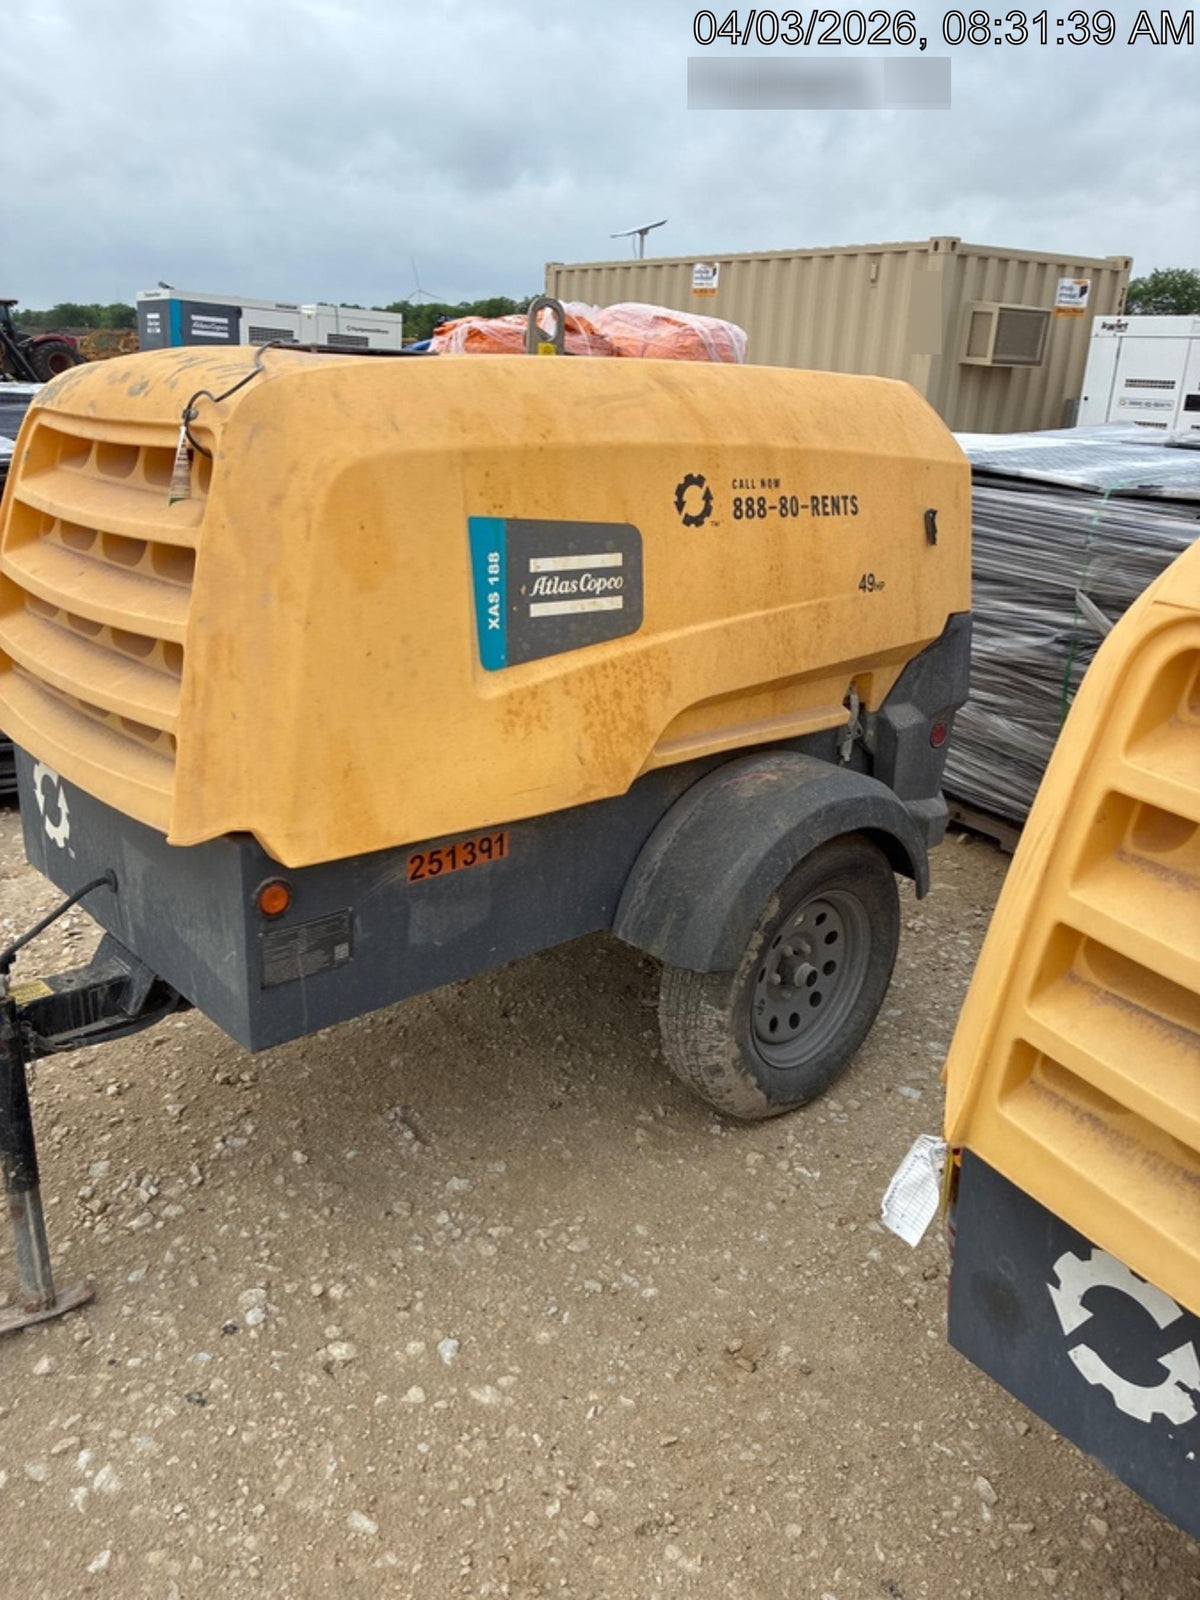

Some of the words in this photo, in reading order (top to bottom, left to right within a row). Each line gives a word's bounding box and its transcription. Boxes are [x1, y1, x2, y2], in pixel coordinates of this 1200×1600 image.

[732, 479, 756, 490] CALL
[760, 478, 781, 489] NOW
[732, 494, 859, 520] 888-80-RENTS
[487, 552, 500, 585] 188
[530, 575, 578, 596] Atlas
[579, 573, 624, 595] Copco
[487, 592, 500, 630] XAS
[409, 832, 506, 881] 251391
